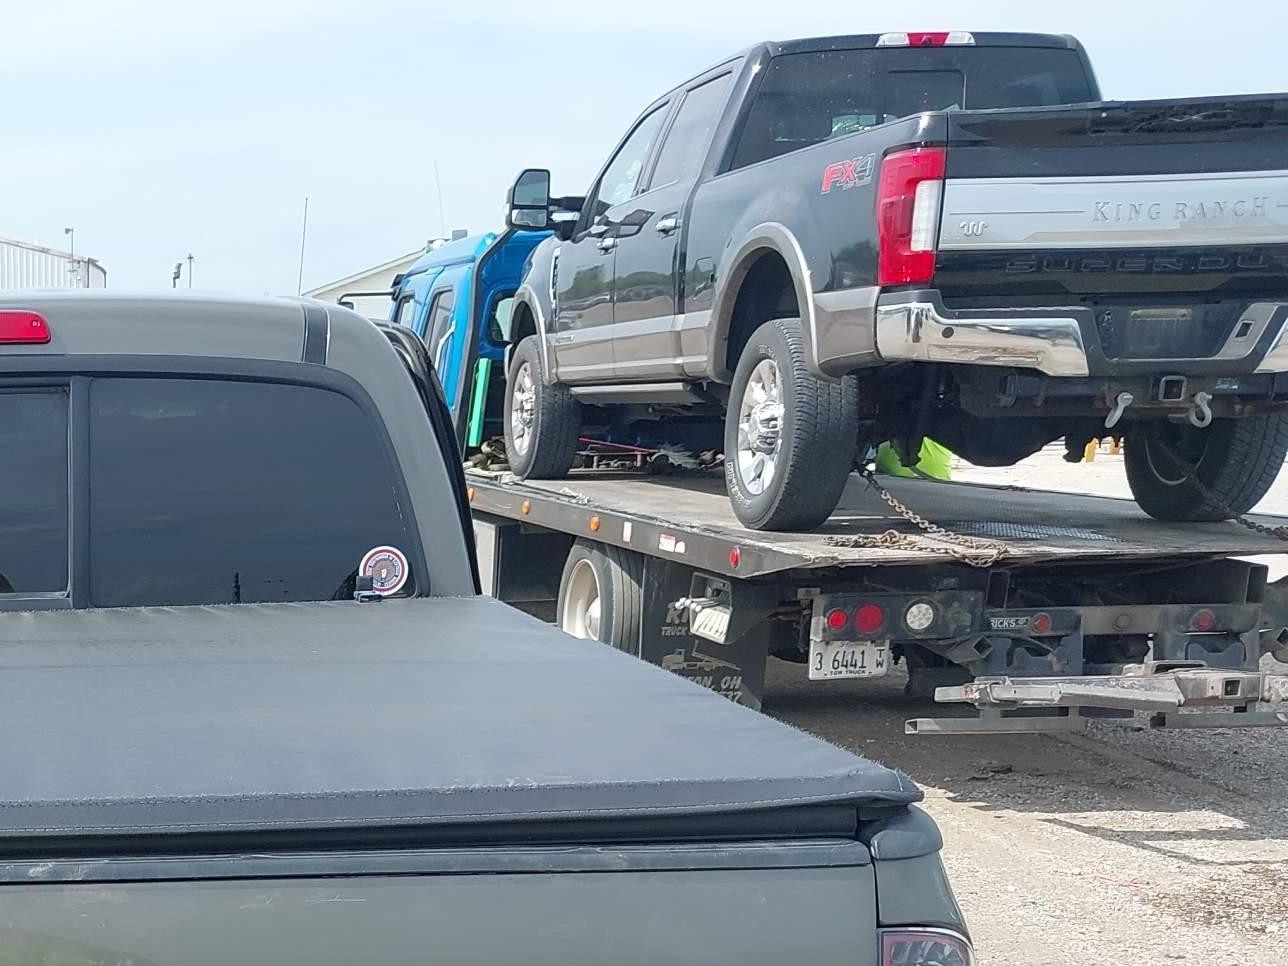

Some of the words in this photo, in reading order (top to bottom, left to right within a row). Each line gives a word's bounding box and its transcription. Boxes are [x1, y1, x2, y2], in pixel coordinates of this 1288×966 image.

[820, 152, 876, 194] FX4
[1092, 200, 1161, 223] KING
[1174, 197, 1271, 220] RANCH
[1006, 256, 1185, 274] SUPER
[814, 652, 824, 672] 3
[831, 649, 868, 671] 6441
